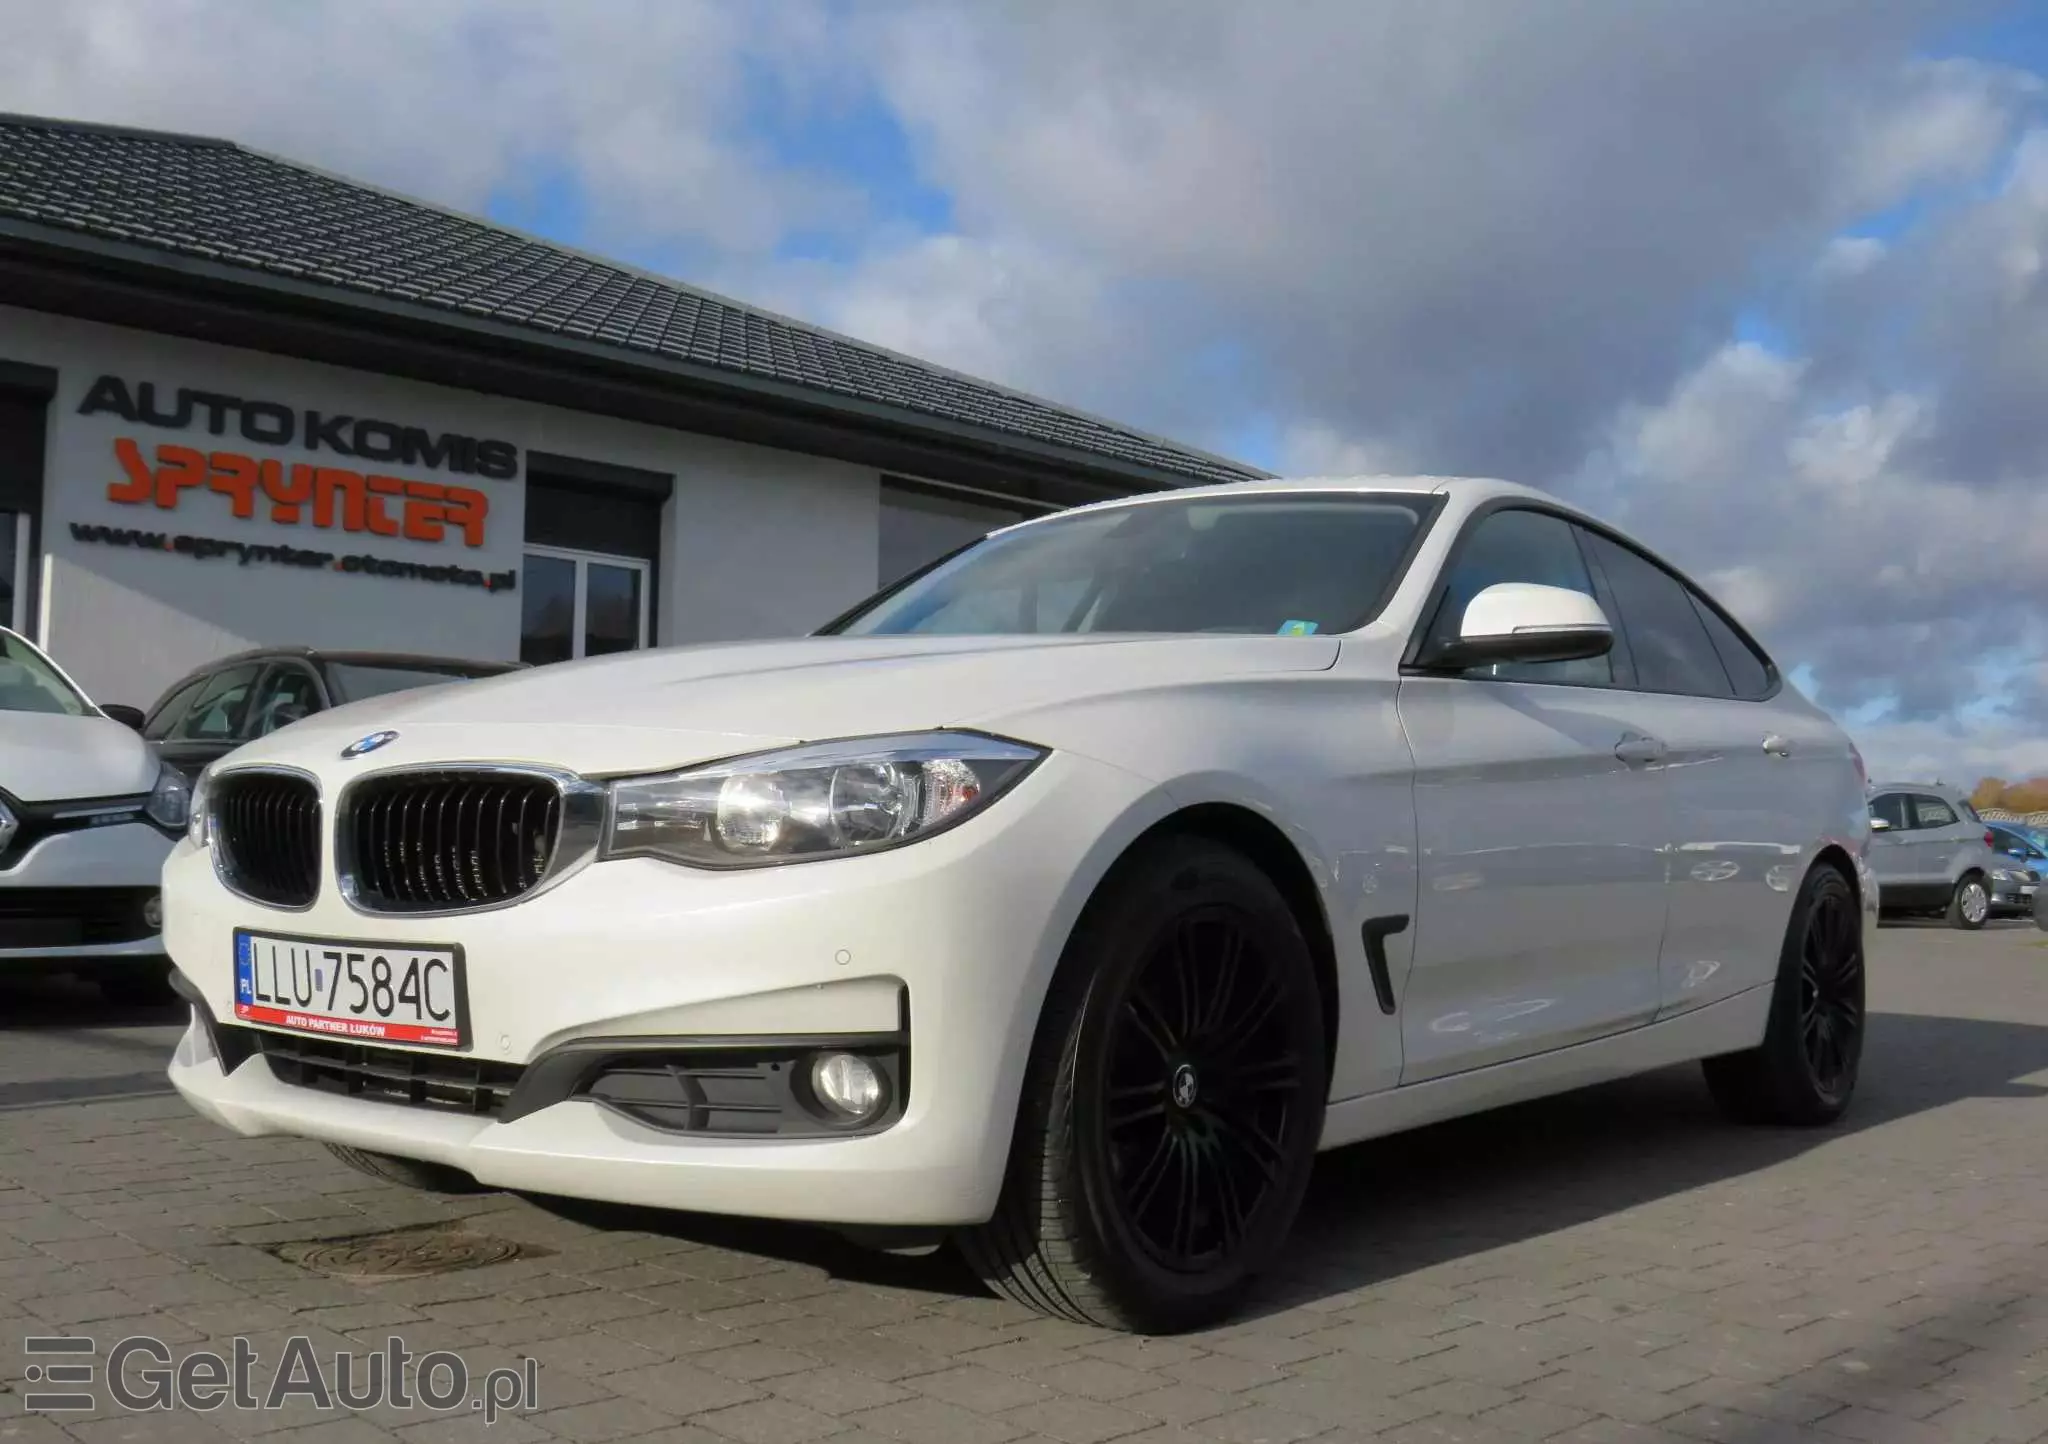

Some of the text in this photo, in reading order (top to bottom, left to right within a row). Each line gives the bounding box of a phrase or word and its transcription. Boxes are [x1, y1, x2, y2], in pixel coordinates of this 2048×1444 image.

[77, 376, 518, 479] AUTO KOMIS
[108, 438, 488, 547] SPRYNTER
[253, 943, 451, 1022] LLU 7584C
[286, 1015, 308, 1027] AUTO
[309, 1018, 348, 1033] PARTNER
